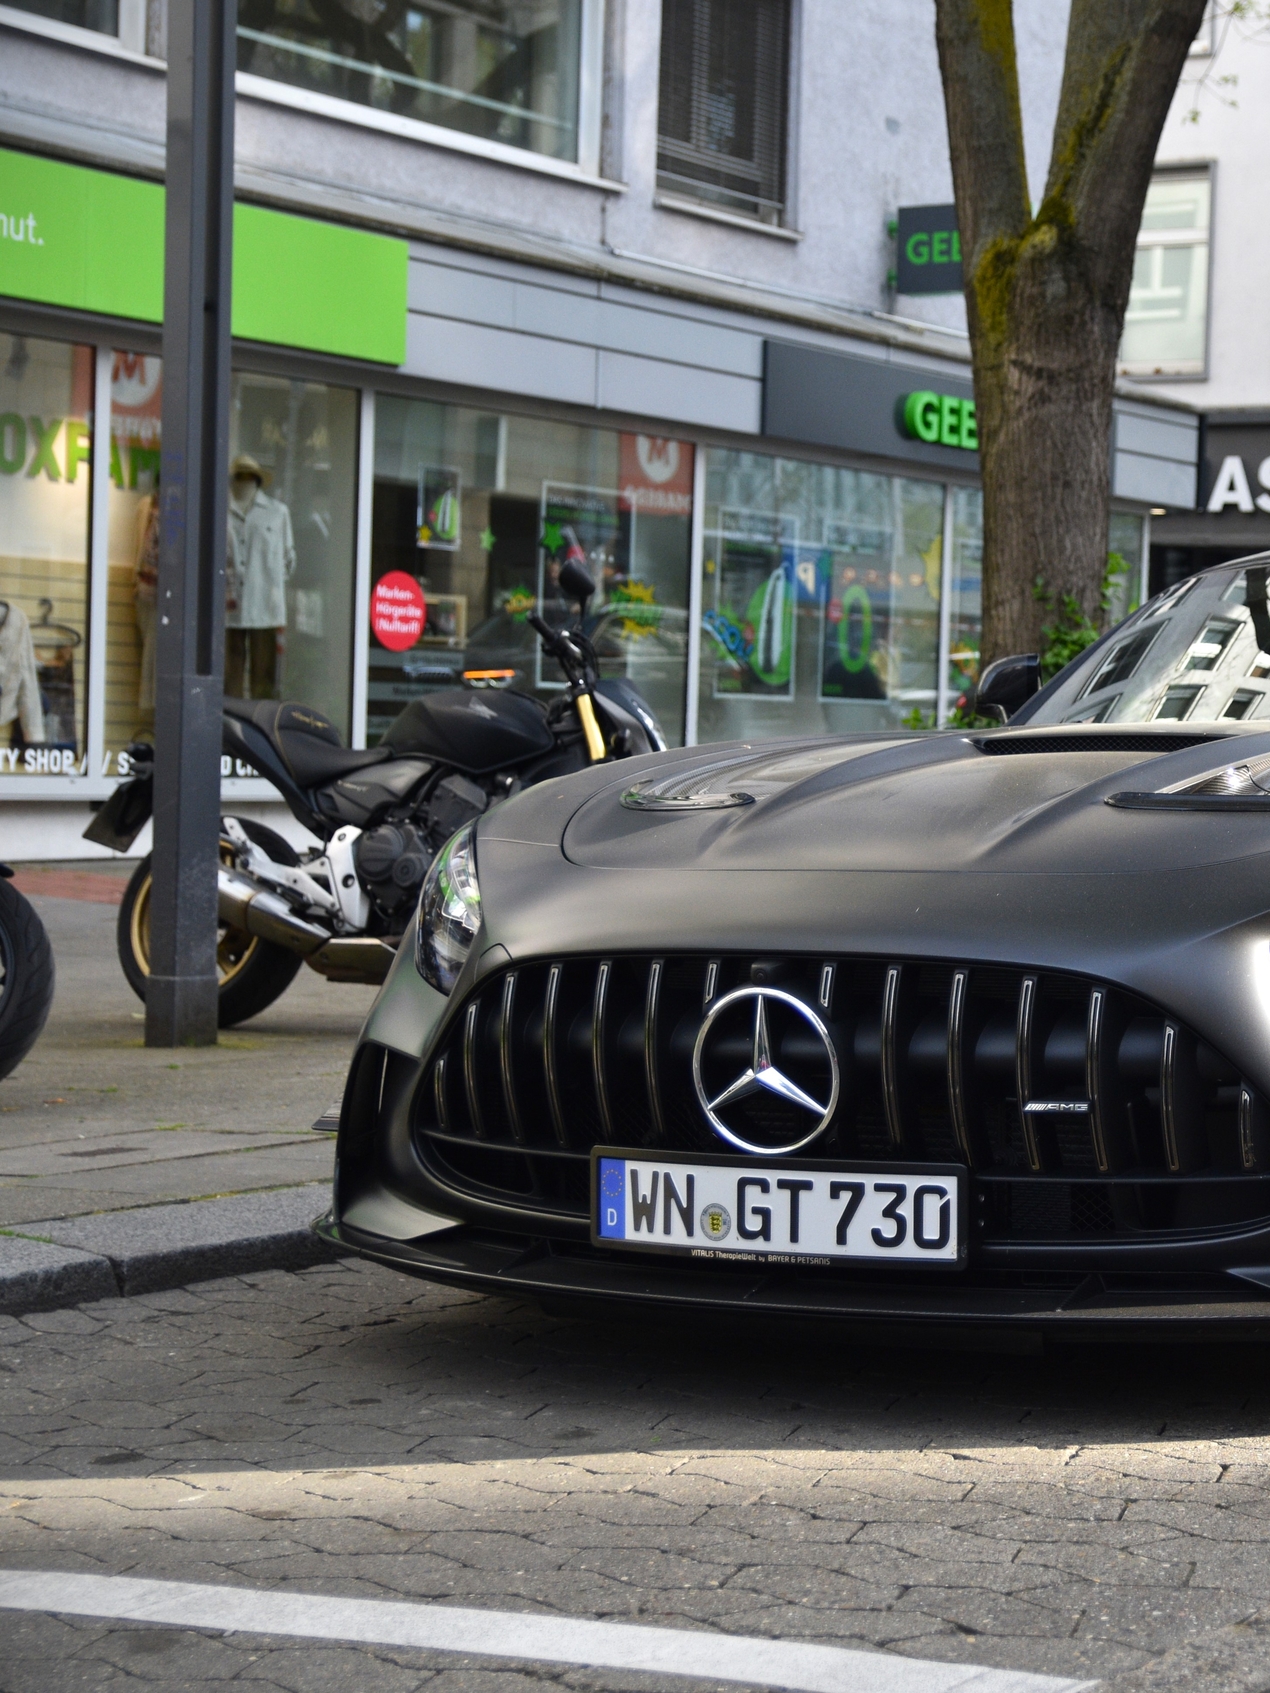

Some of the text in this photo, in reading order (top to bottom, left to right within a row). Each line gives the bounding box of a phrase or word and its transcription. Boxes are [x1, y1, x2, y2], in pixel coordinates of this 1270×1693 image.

[376, 584, 416, 601] Marken-
[376, 601, 422, 619] Hörgeräte
[24, 749, 75, 774] SHOP
[1045, 1103, 1088, 1111] AMG
[607, 1208, 618, 1226] D
[630, 1168, 951, 1250] WN GT 730
[691, 1249, 714, 1258] VITALIS
[767, 1255, 790, 1263] BAYER
[797, 1257, 831, 1265] PETSANIS
